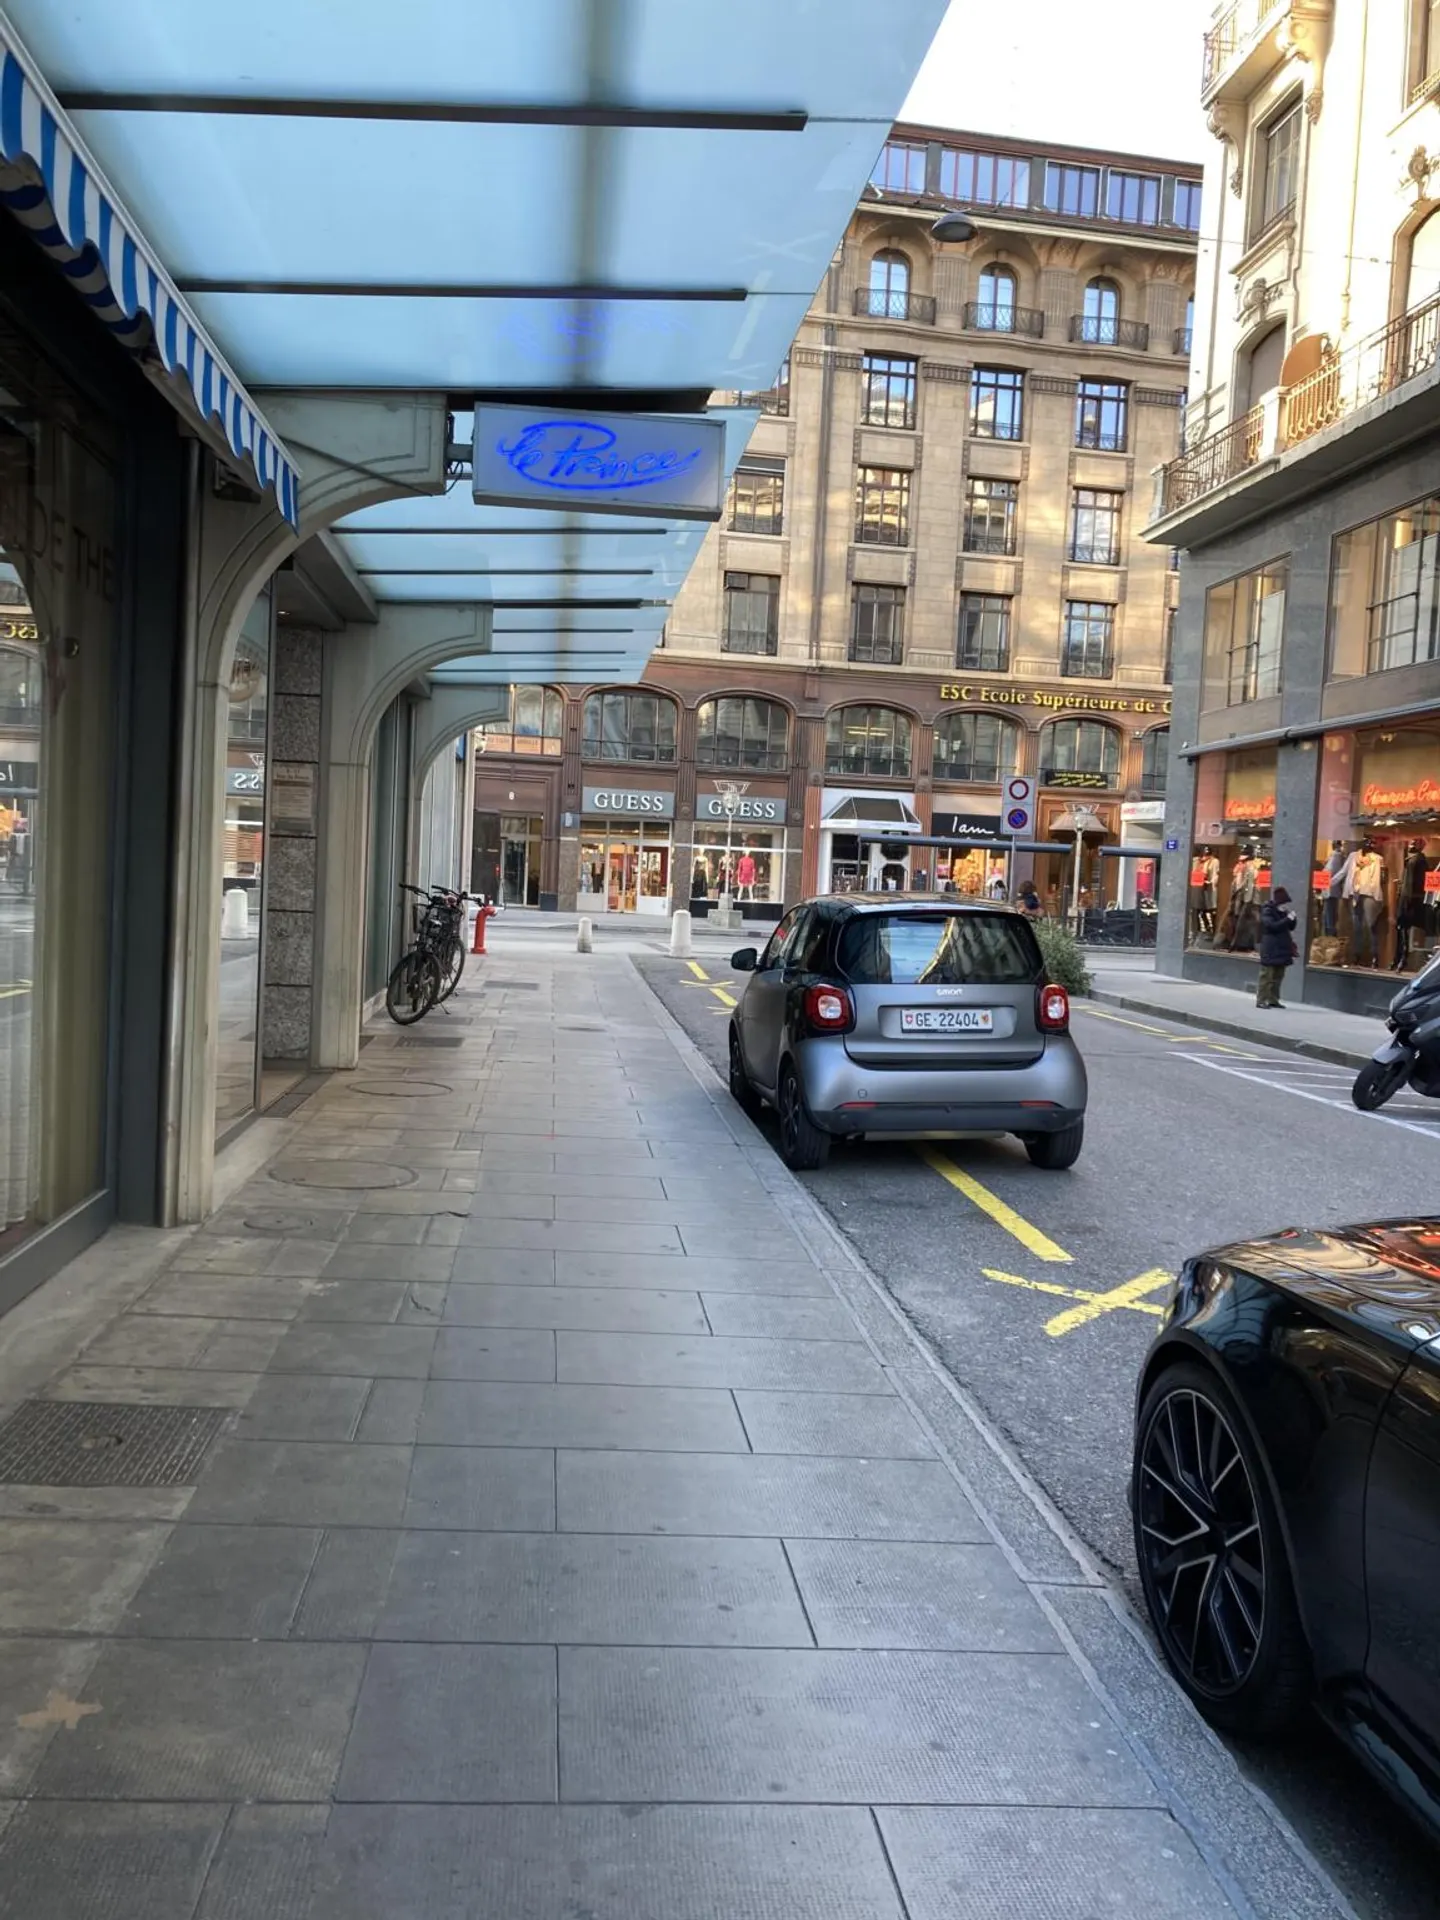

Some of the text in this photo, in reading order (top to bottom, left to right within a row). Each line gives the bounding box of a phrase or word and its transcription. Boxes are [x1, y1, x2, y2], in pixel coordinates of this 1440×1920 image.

[940, 684, 973, 701] ESC
[981, 687, 1026, 704] Ecole
[1032, 691, 1128, 711] Supérieure
[1134, 698, 1155, 713] de
[594, 792, 664, 812] GUESS
[939, 1012, 979, 1027] 22404
